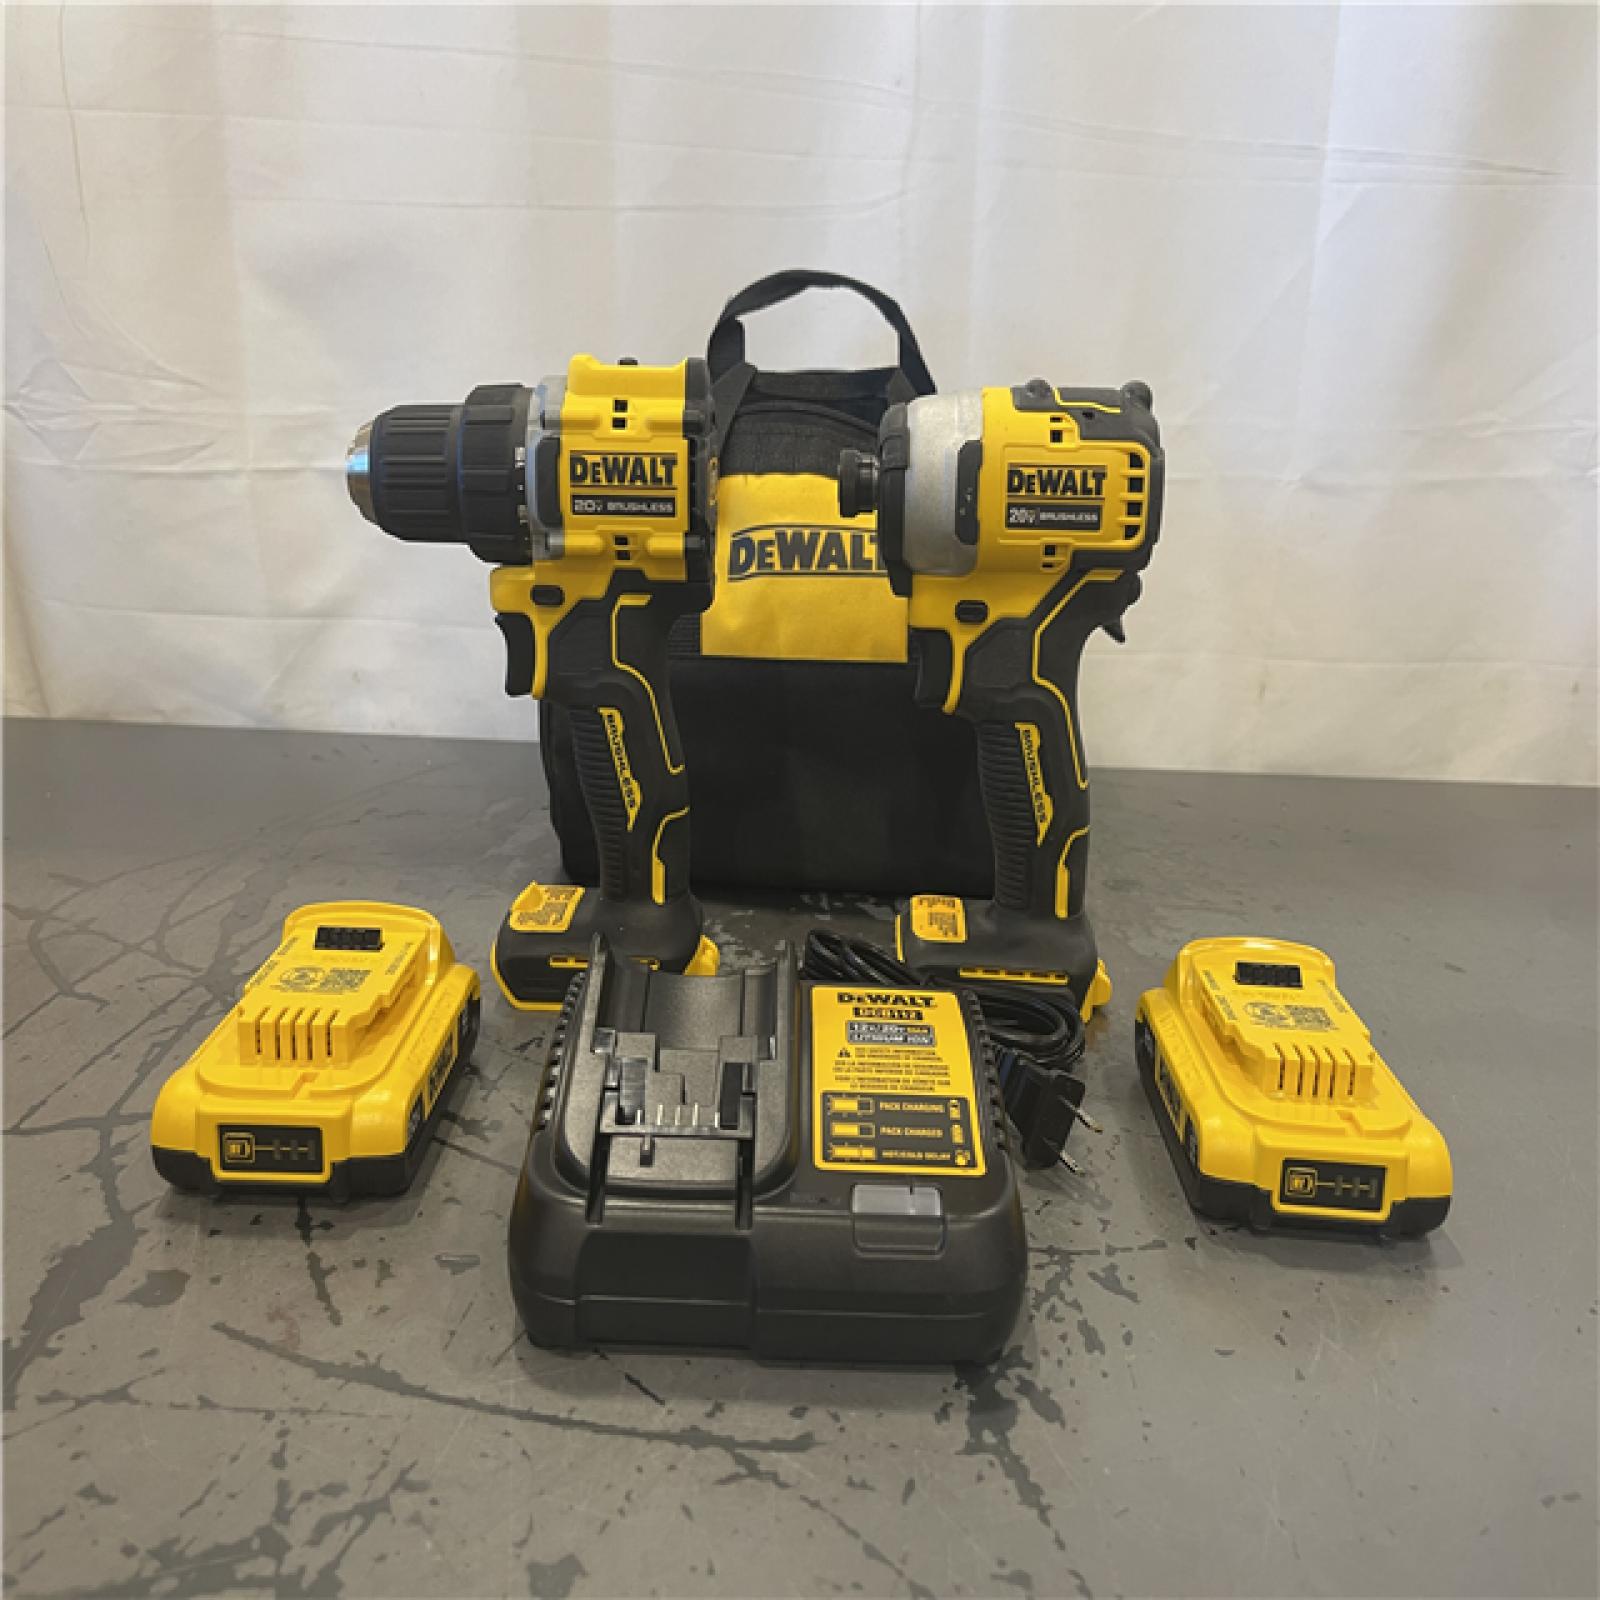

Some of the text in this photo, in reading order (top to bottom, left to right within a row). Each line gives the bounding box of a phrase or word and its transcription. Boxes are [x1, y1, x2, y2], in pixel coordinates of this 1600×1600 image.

[570, 456, 677, 484] DEWALT
[1007, 468, 1107, 496] DEWALT
[606, 501, 673, 513] BRUSHLESS
[1040, 511, 1099, 522] BRUSHLESS
[606, 714, 636, 808] BRUSHLESS
[1023, 729, 1047, 823] BRUSHLESS
[838, 992, 935, 1007] DEWALT
